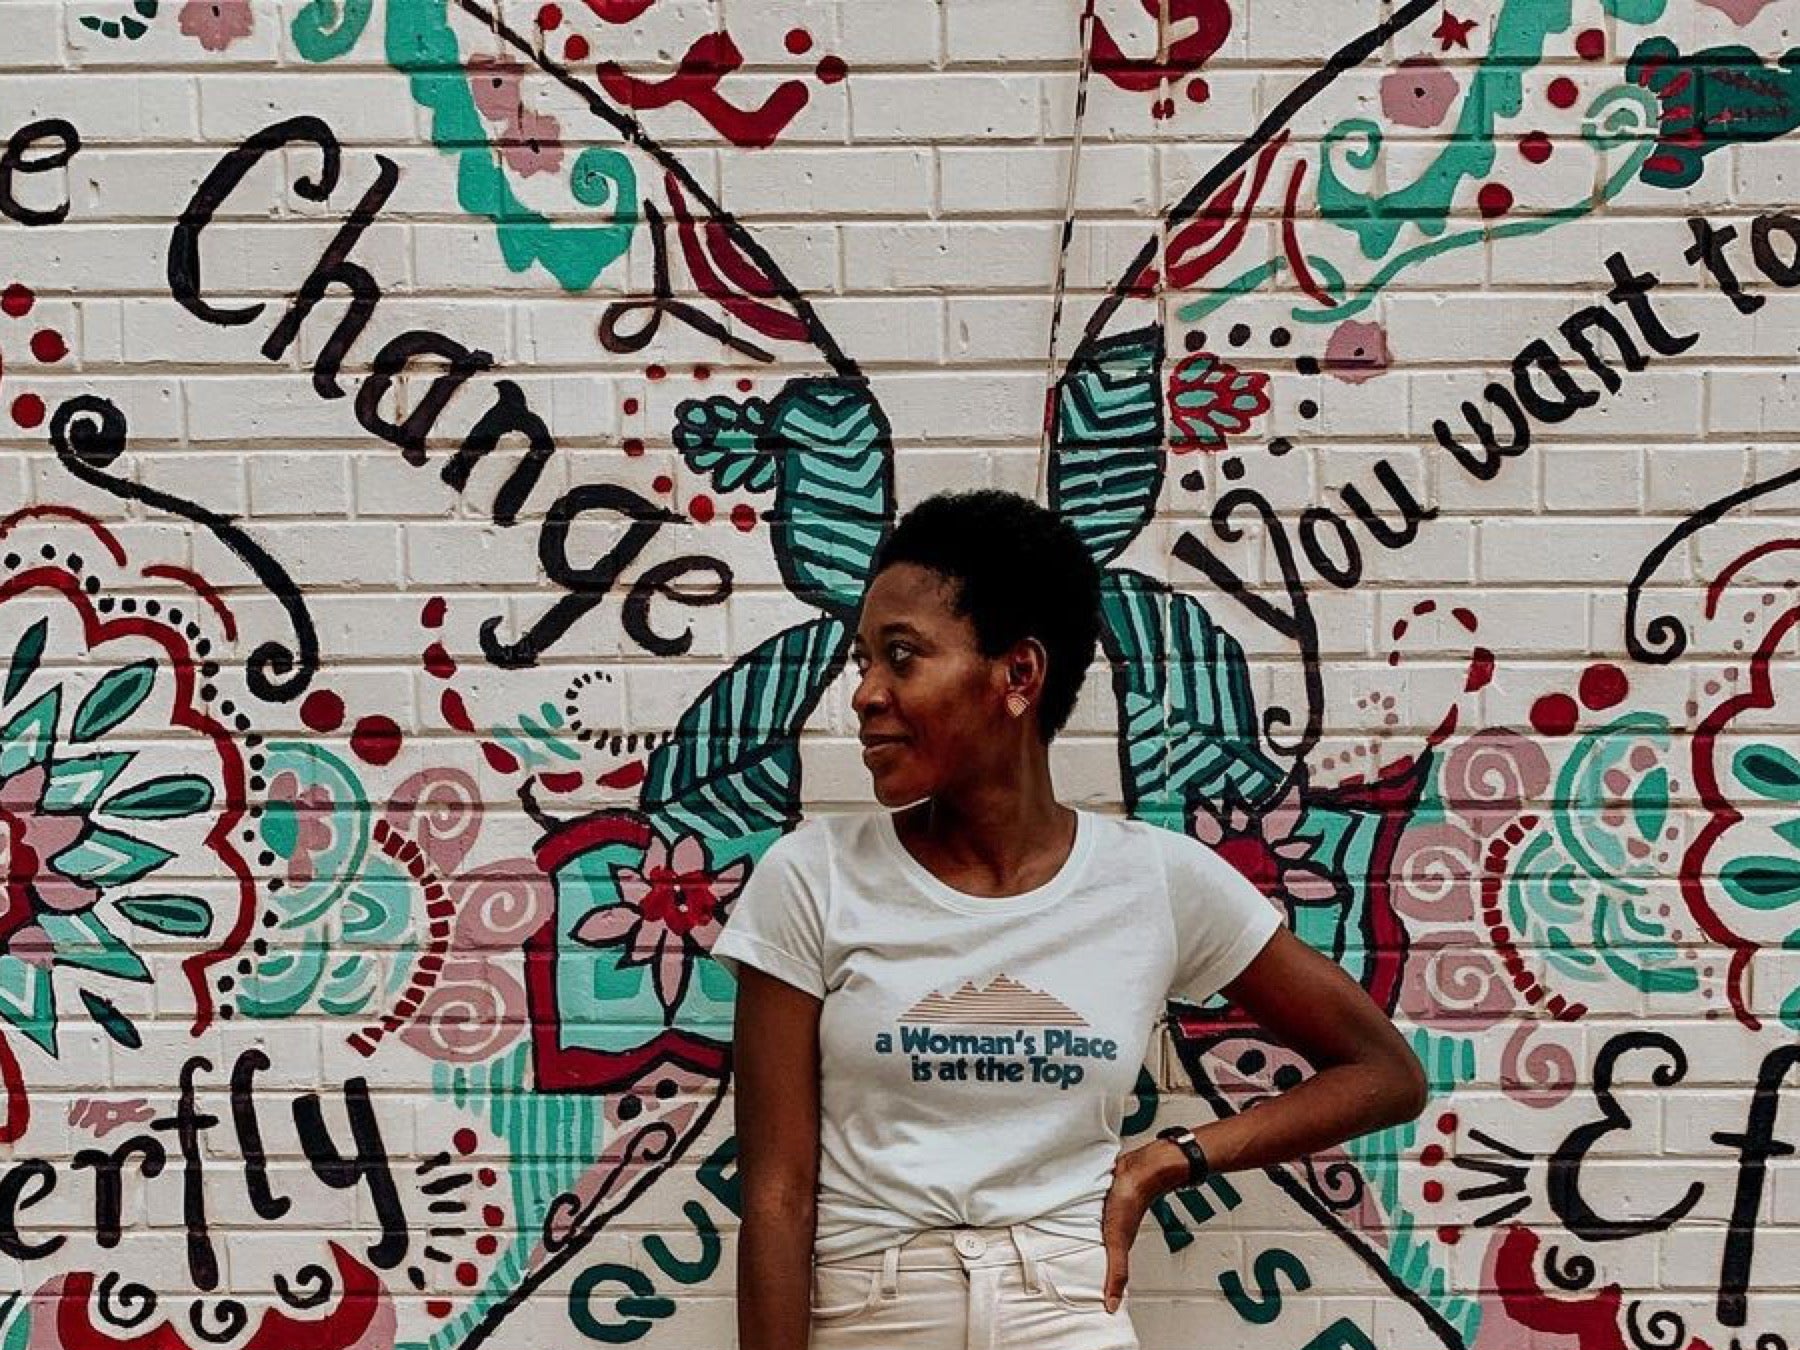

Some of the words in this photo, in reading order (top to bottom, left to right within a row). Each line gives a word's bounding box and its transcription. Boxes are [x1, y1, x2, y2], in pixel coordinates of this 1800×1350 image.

[168, 116, 733, 668] Change
[1172, 460, 1439, 755] You
[1433, 251, 1700, 481] want
[1684, 214, 1800, 315] to
[874, 1031, 893, 1054] a
[900, 1026, 1036, 1056] Woman's
[1043, 1029, 1118, 1061] Place
[938, 1058, 968, 1082] at
[975, 1055, 1024, 1083] the
[1028, 1056, 1085, 1091] Top
[0, 1050, 409, 1291] erfly
